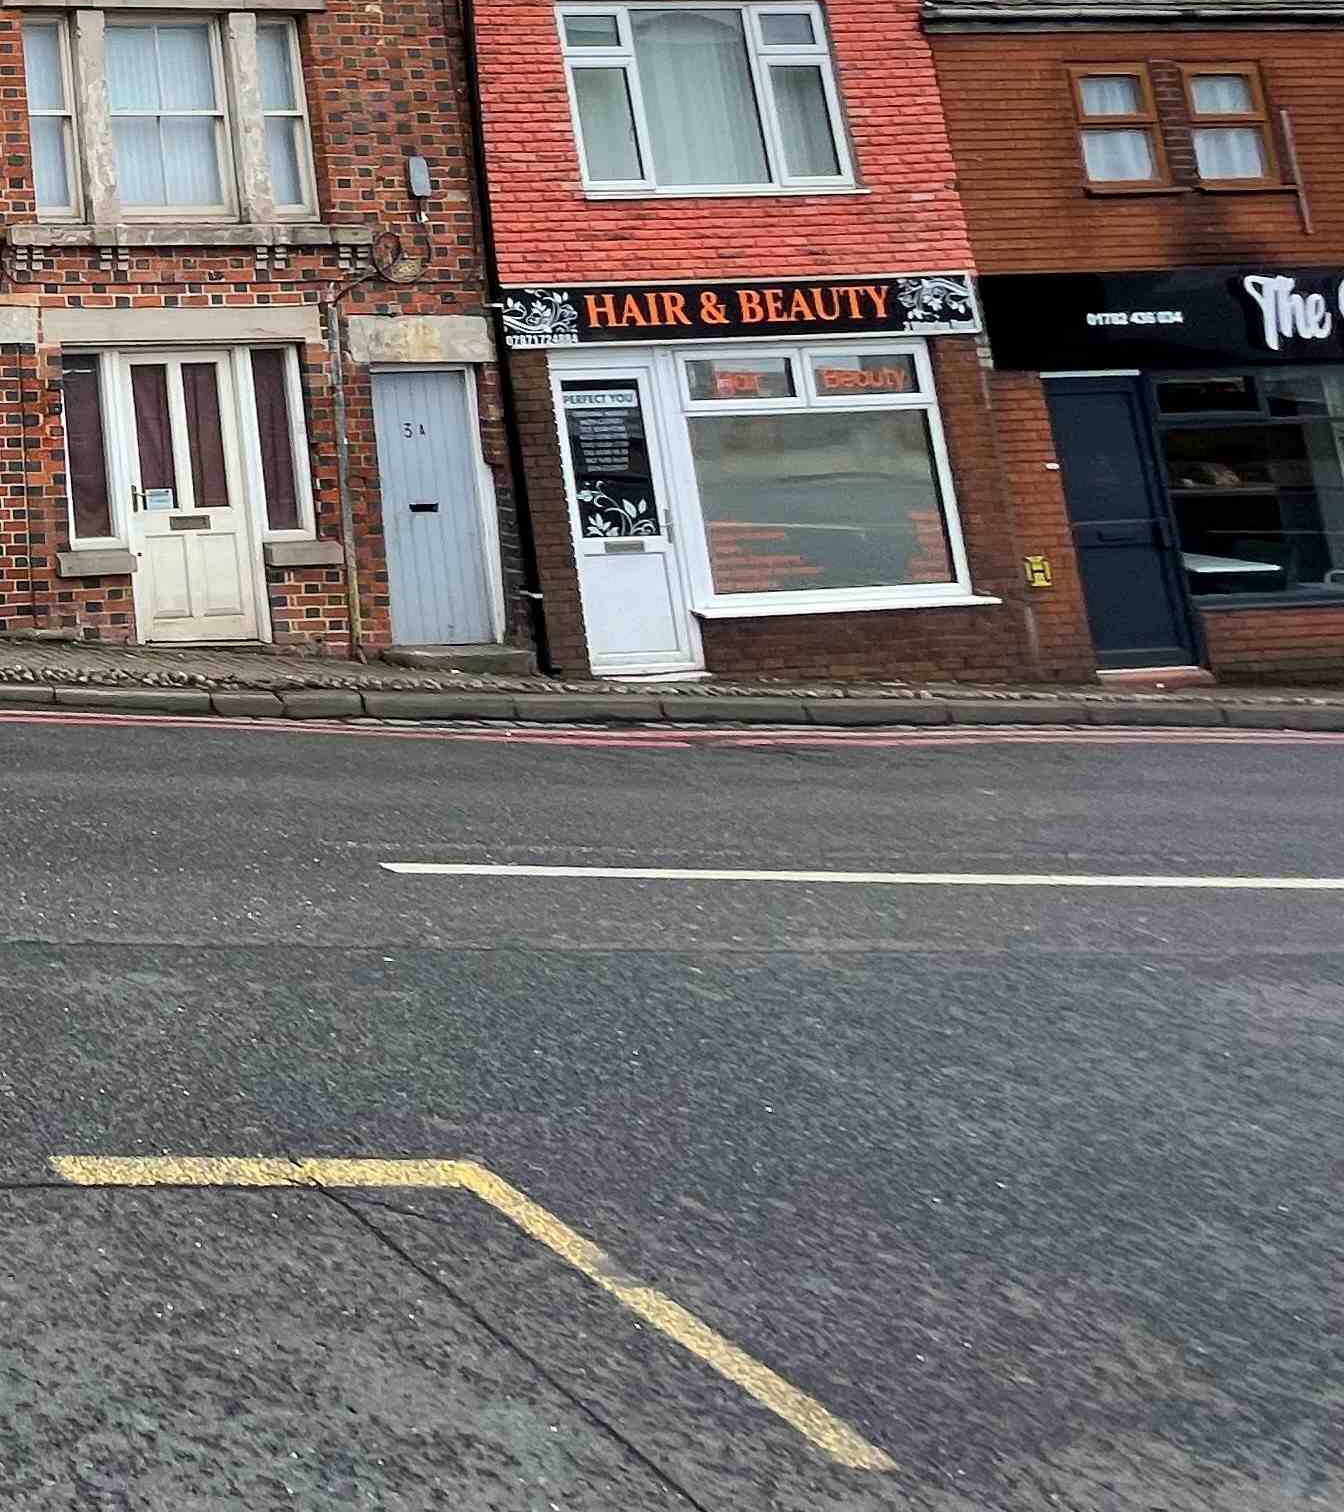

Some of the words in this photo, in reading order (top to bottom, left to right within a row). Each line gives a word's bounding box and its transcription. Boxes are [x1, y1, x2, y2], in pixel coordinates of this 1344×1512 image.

[583, 291, 693, 328] HAIR
[699, 290, 731, 325] &
[735, 284, 890, 324] BEAUTY
[1244, 275, 1332, 350] The
